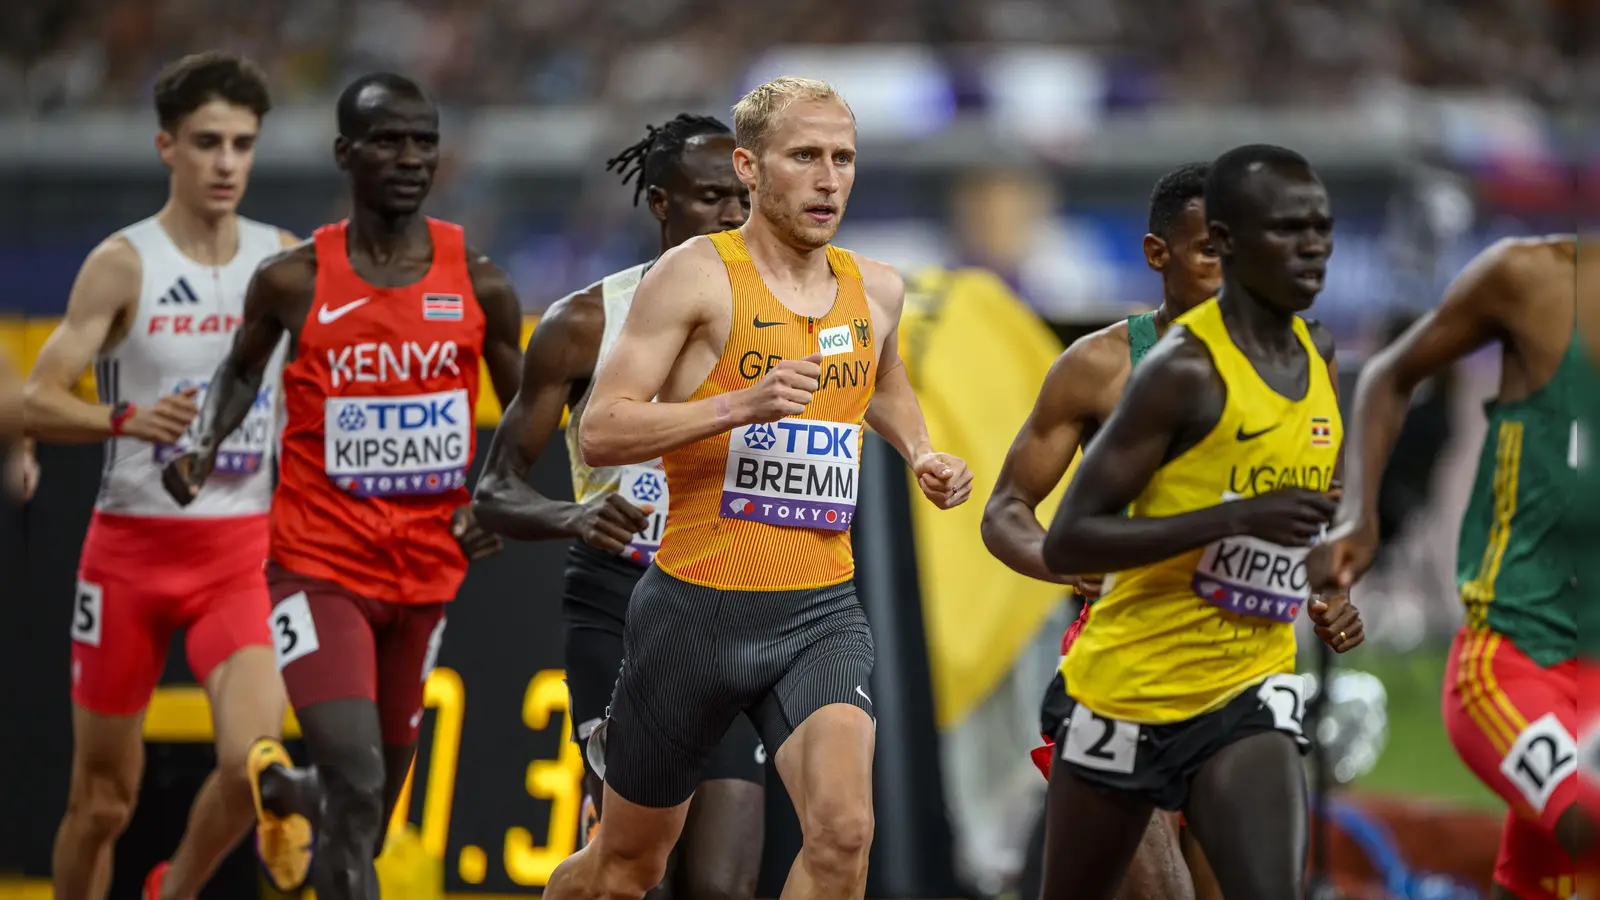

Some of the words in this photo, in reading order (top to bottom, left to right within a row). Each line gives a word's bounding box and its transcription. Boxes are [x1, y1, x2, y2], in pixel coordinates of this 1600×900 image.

[818, 331, 850, 349] WGV
[327, 340, 460, 388] KENYA
[739, 350, 870, 392] GANY
[366, 398, 457, 431] TDK
[335, 433, 462, 468] KIPSANG
[777, 421, 853, 459] TDK
[735, 457, 853, 499] BREMM
[1230, 464, 1332, 496] UGAND
[76, 594, 94, 632] 5
[1231, 592, 1299, 617] TOKYO
[276, 615, 297, 655] 3
[1084, 710, 1116, 761] 2
[1515, 734, 1574, 793] 12
